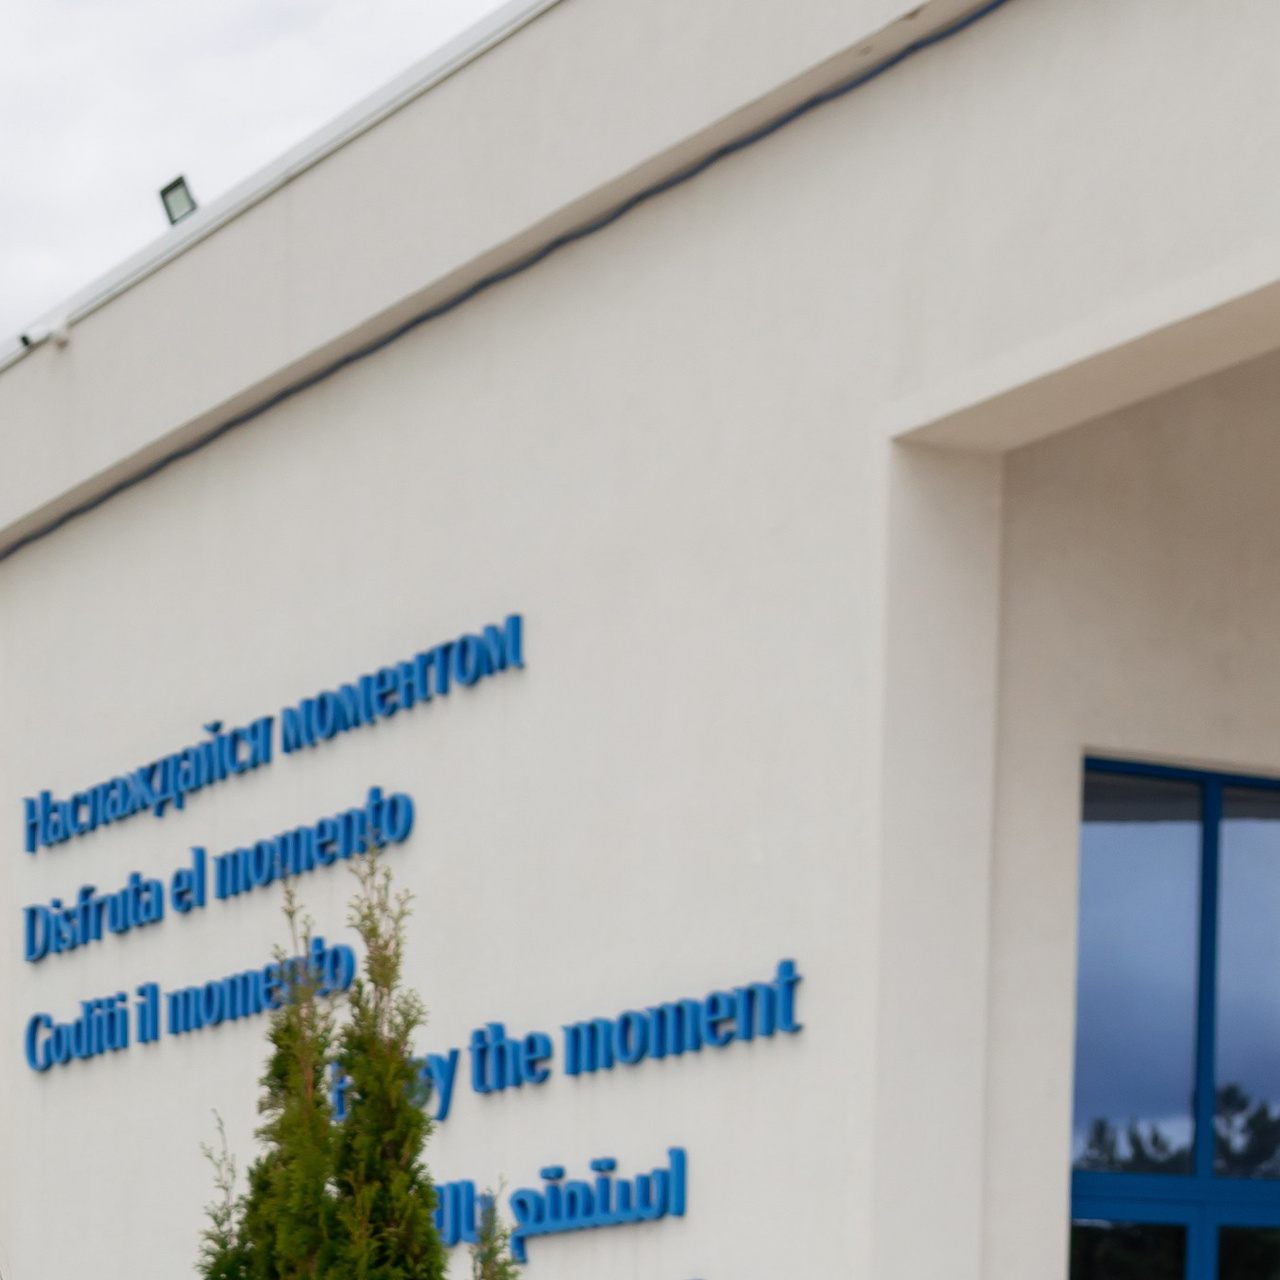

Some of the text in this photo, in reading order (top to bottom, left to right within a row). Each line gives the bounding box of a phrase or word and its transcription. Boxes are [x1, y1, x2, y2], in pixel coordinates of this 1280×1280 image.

[23, 614, 524, 853] Наслаждайся моментом
[23, 786, 415, 962] Disfruta el momento
[135, 982, 161, 1044] il
[469, 1021, 553, 1094] the
[562, 959, 802, 1077] moment
